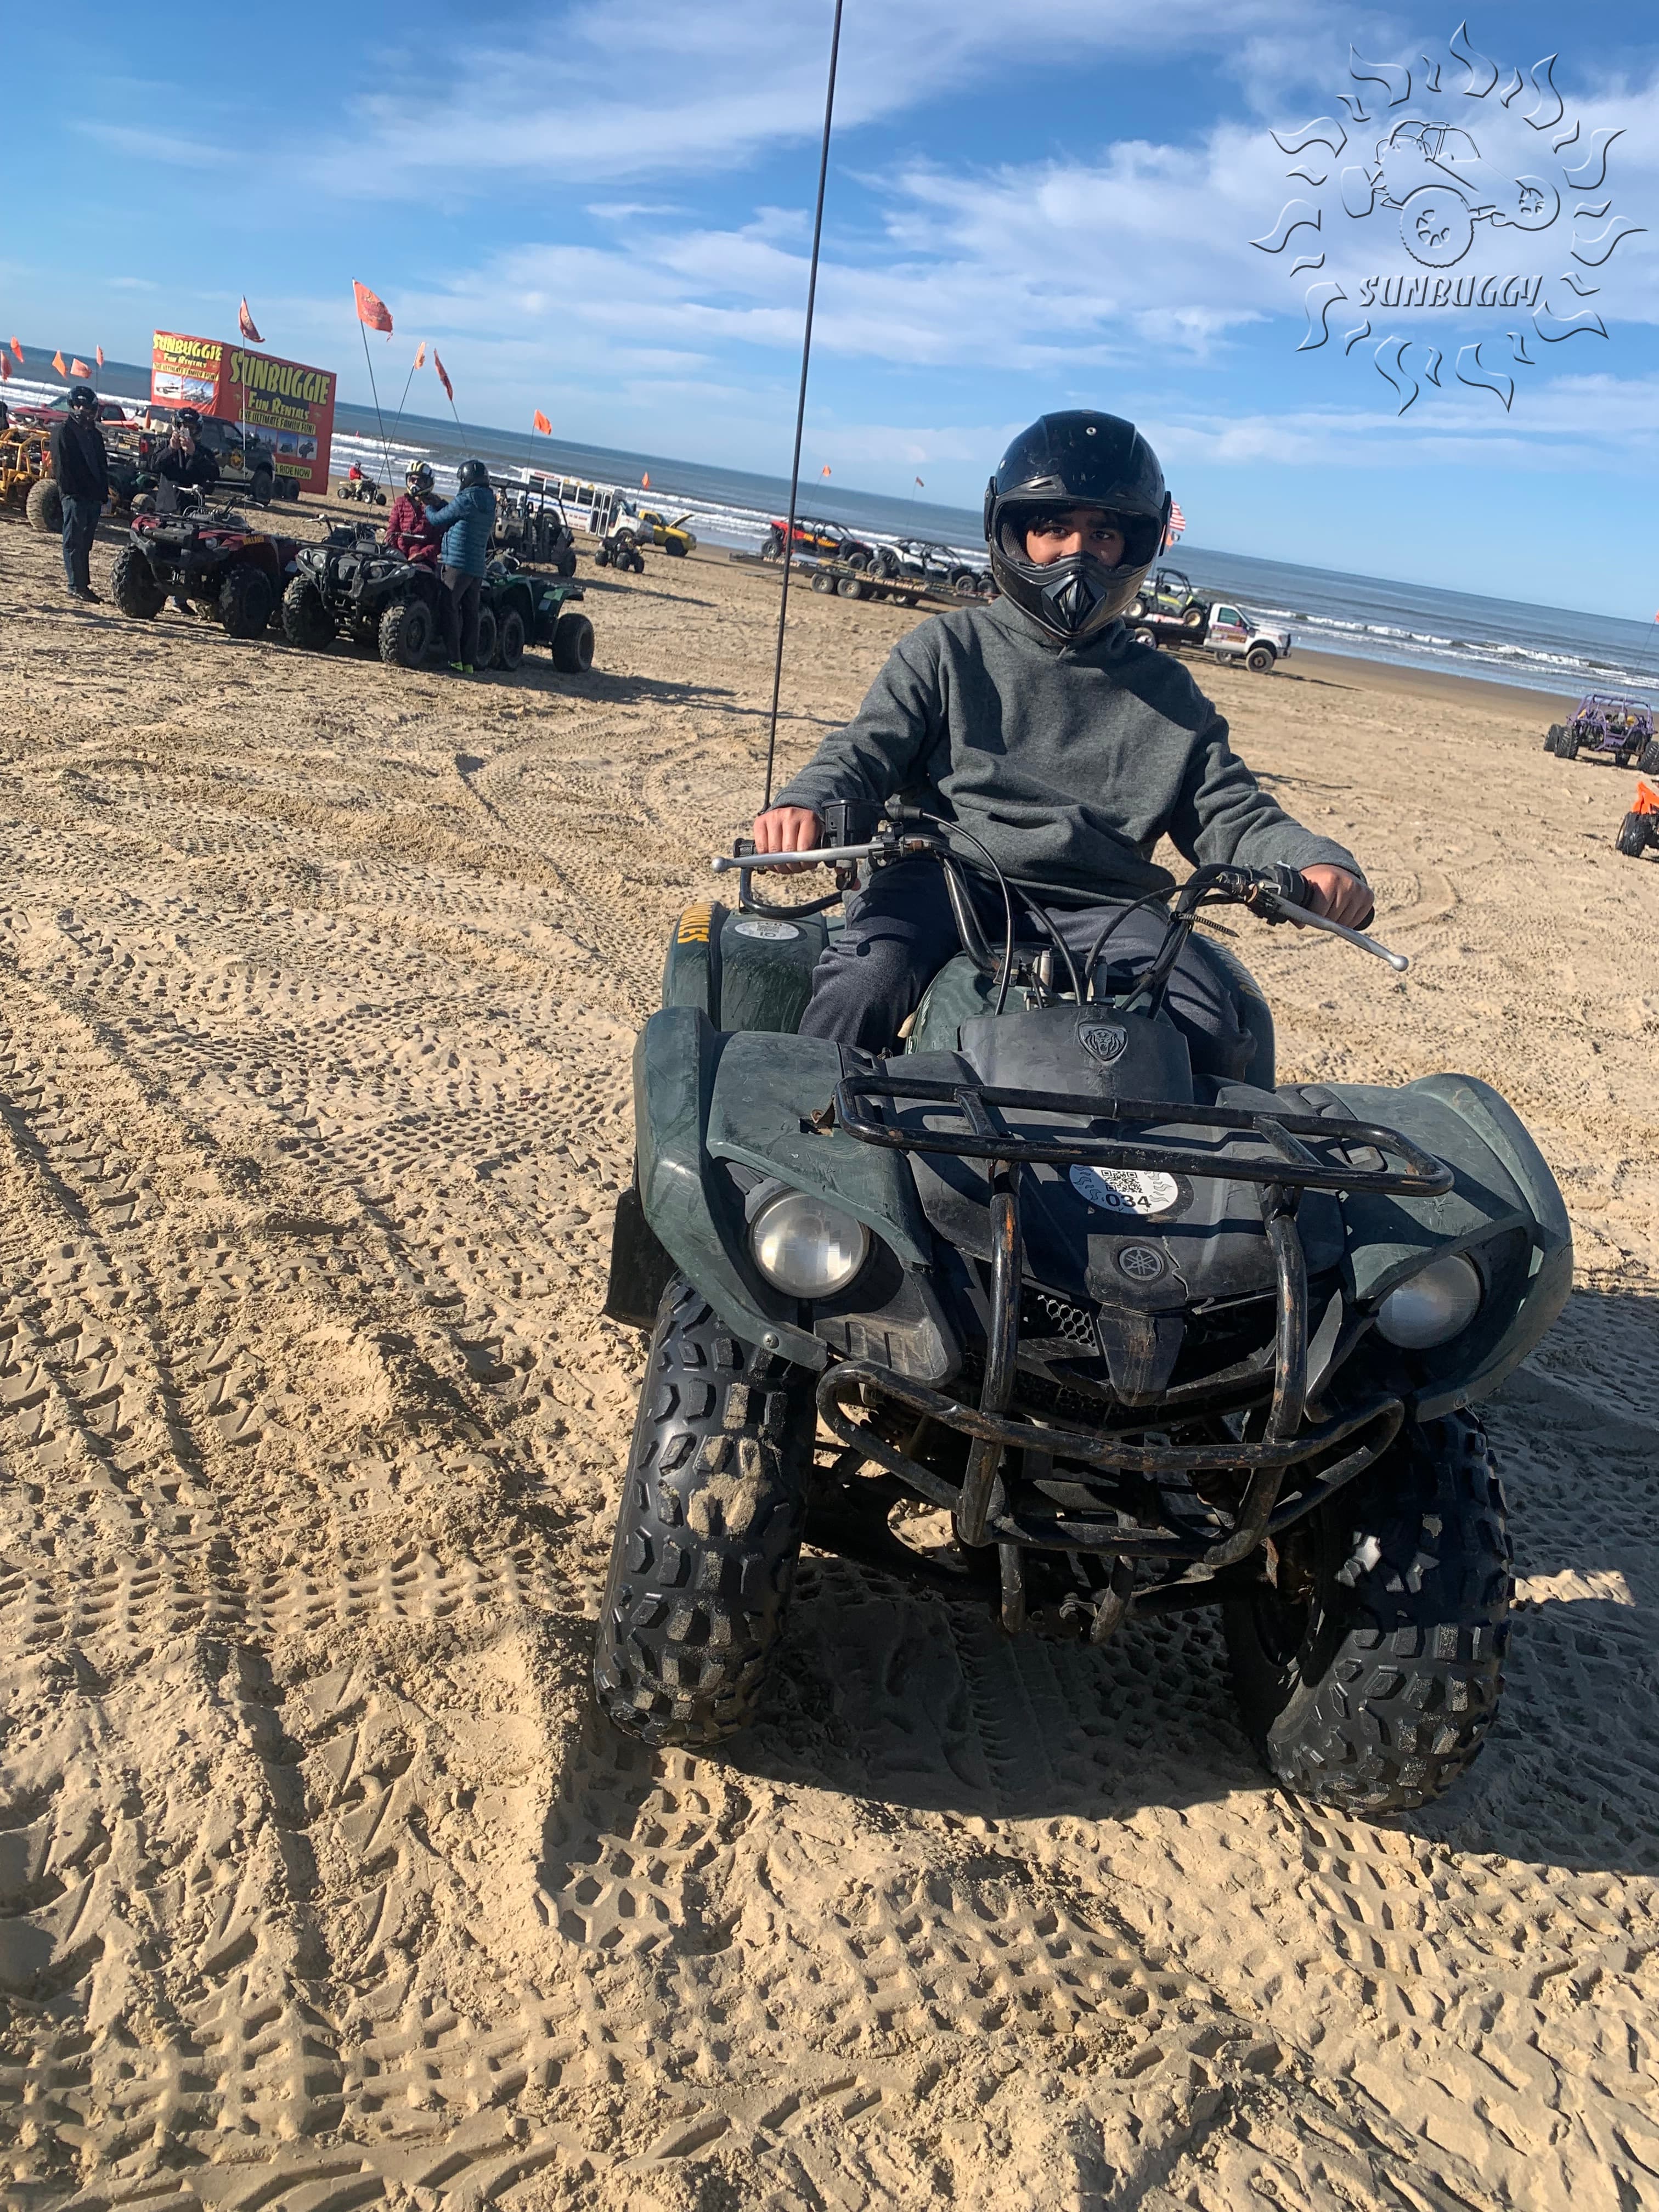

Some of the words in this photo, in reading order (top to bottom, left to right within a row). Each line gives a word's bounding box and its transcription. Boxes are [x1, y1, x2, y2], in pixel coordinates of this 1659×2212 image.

[153, 333, 223, 361] SUNBUGGIE
[229, 351, 331, 405] SUNBUGGIE
[248, 391, 269, 411] FUN
[272, 397, 310, 420] RENTALS
[280, 465, 293, 476] RIDE
[294, 469, 311, 478] NOW
[1105, 1194, 1152, 1207] 034
